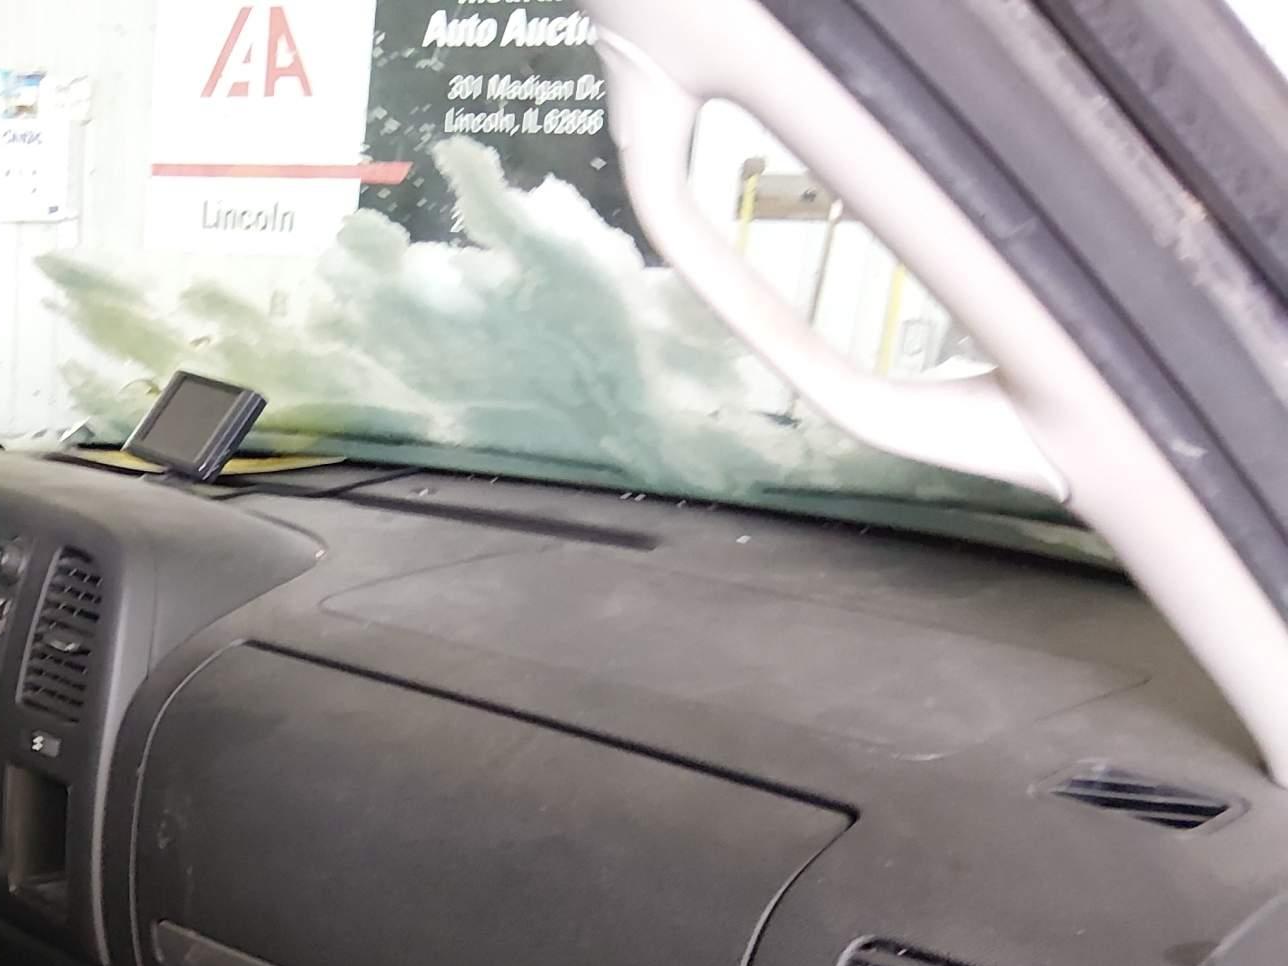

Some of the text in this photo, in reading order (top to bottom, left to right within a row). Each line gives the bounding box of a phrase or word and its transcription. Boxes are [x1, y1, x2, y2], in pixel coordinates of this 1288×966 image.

[422, 10, 497, 47] Auto
[448, 74, 482, 100] 301
[486, 74, 574, 105] Madigan
[522, 108, 542, 133] IL
[201, 200, 296, 232] Lincoln
